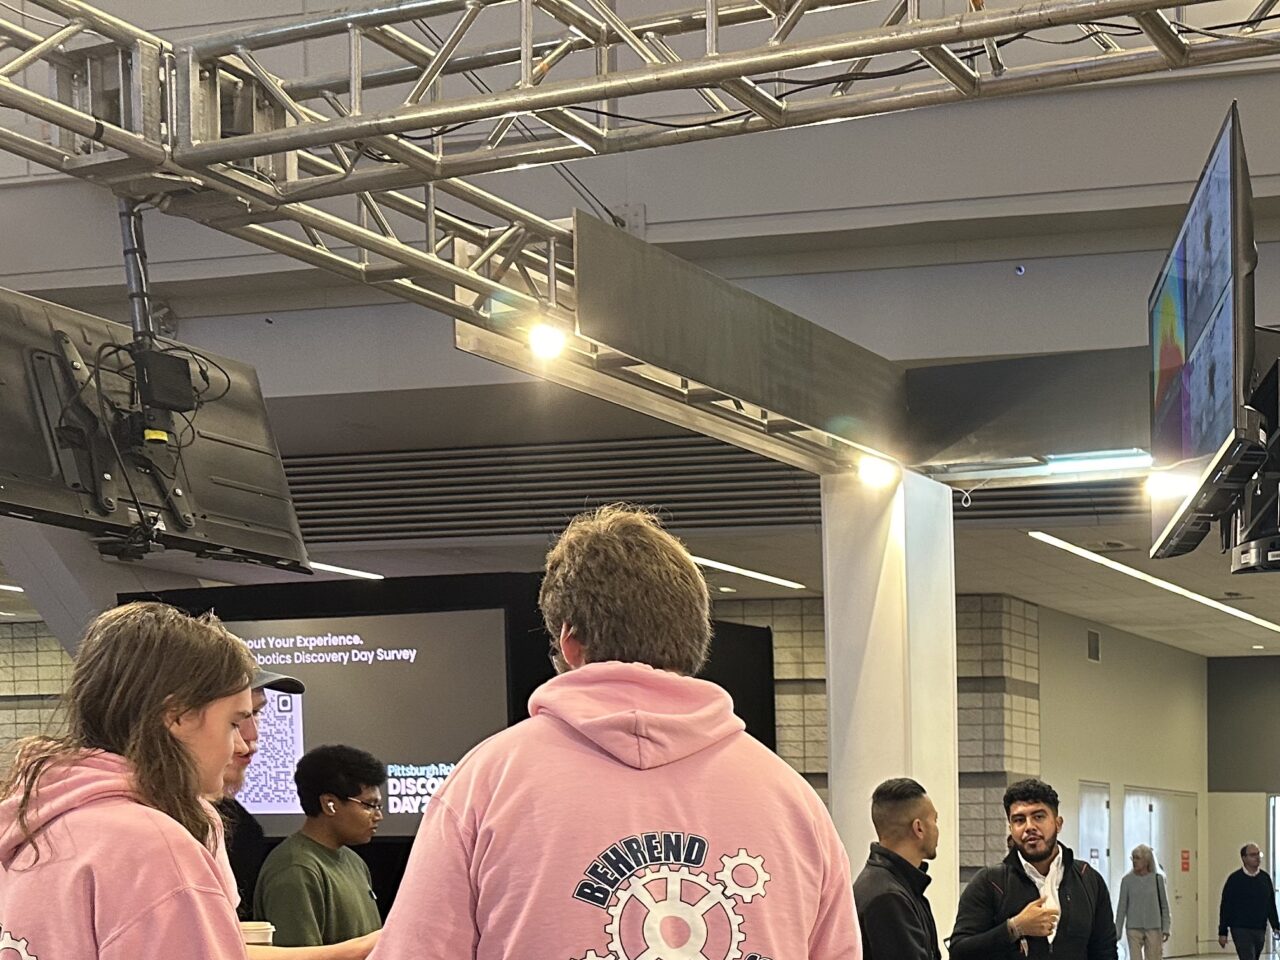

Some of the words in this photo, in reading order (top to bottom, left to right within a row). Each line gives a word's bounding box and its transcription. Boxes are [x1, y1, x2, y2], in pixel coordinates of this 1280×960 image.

[246, 637, 266, 649] out
[267, 636, 295, 649] Your
[296, 633, 364, 651] Experience.
[294, 650, 349, 666] Discovery
[351, 649, 375, 665] Day
[376, 647, 417, 664] Survey
[387, 763, 438, 778] Pittsburgh
[388, 796, 421, 814] DAY
[573, 832, 709, 909] BEHREND
